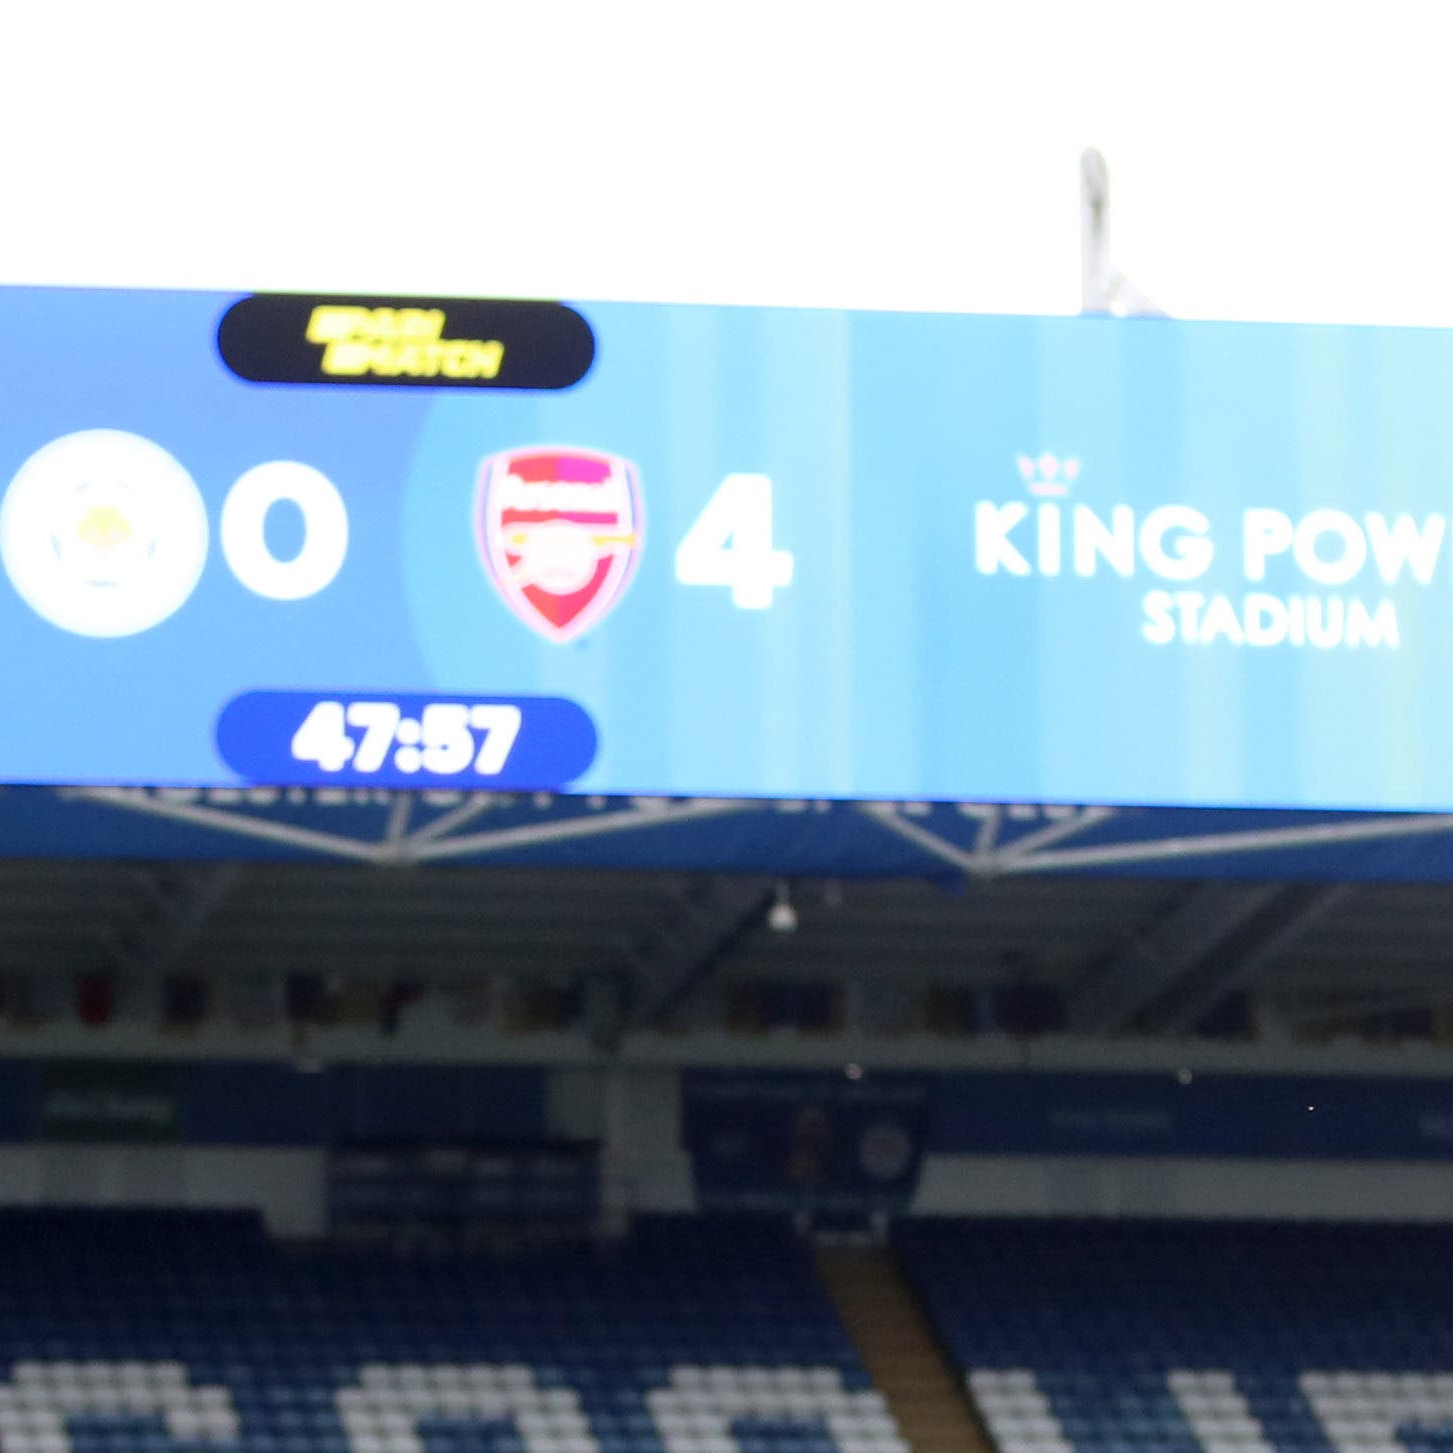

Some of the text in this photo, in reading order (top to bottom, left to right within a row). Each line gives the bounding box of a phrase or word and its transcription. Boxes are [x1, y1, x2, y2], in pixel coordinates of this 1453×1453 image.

[220, 459, 349, 600] 0
[675, 472, 794, 610] 4
[974, 500, 1215, 581] KING
[1142, 589, 1401, 651] STADIUM
[291, 700, 521, 776] 47:57
